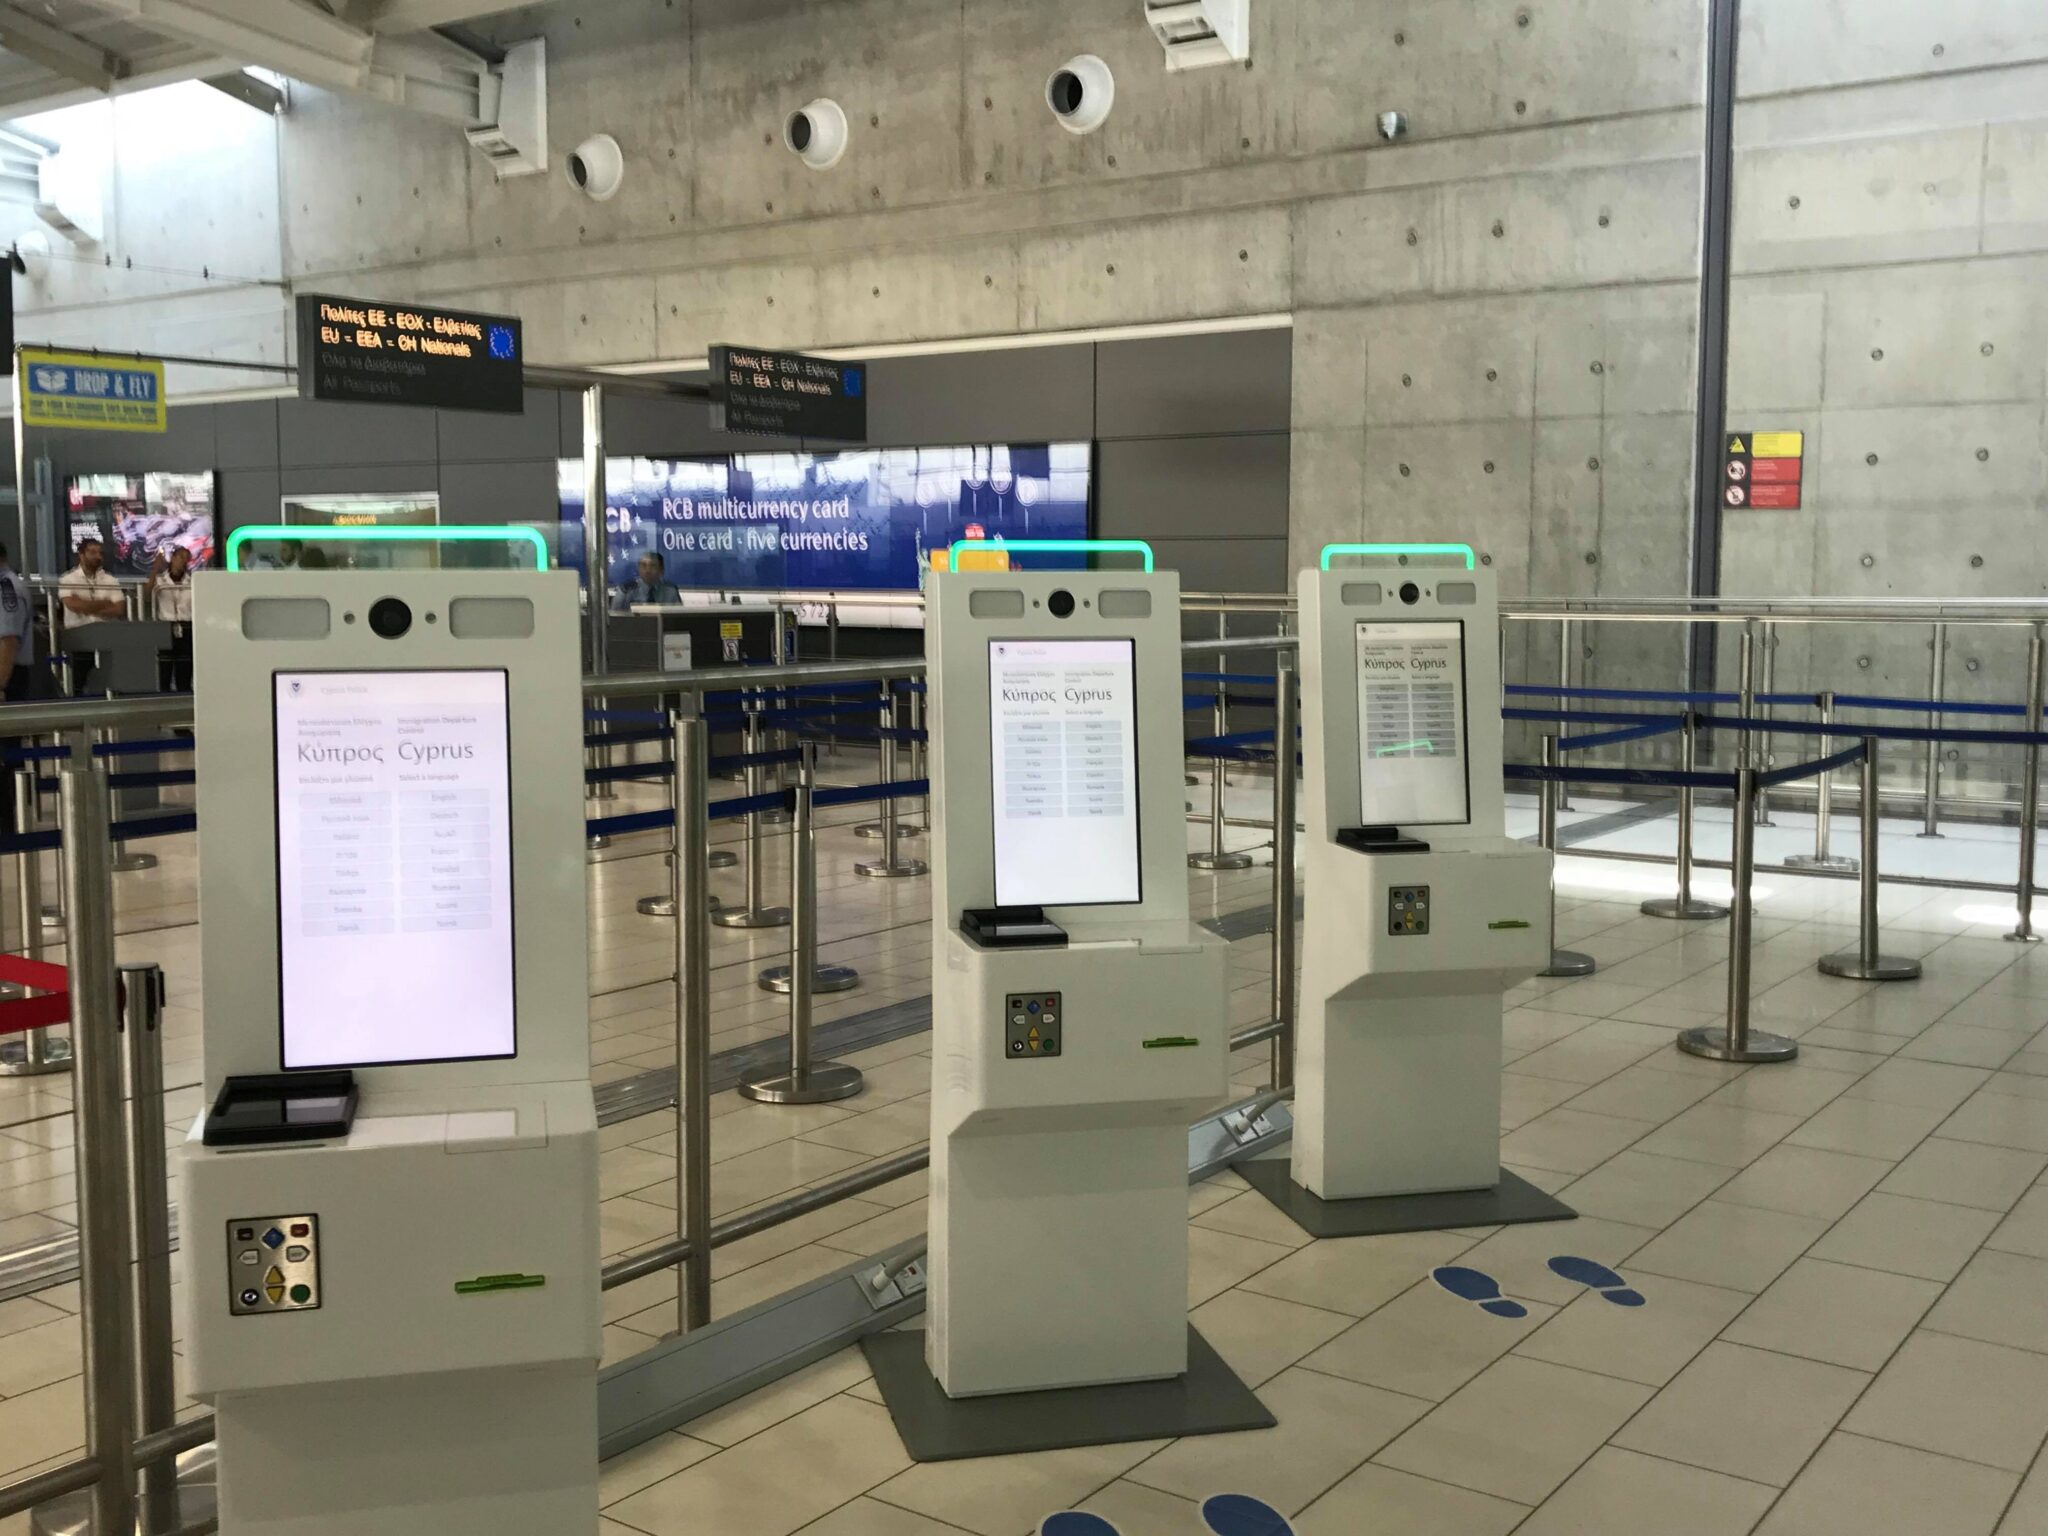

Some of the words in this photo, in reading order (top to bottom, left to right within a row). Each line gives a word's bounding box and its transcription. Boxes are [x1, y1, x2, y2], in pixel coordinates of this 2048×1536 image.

[321, 327, 339, 344] EU
[356, 331, 383, 349] EEA
[398, 335, 417, 351] CH
[421, 337, 471, 358] Nationals
[74, 369, 109, 396] DROP
[114, 374, 125, 397] &
[128, 375, 151, 399] FLY
[606, 506, 631, 533] CB
[663, 497, 694, 520] RCB
[698, 497, 808, 524] multicurrency
[812, 495, 849, 519] card
[663, 527, 695, 551] One
[700, 527, 733, 551] card
[747, 527, 776, 550] five
[780, 527, 868, 551] currencies
[1364, 658, 1405, 671] Κύπρος
[1410, 658, 1447, 671] Cyprus
[1002, 688, 1056, 704] Κύπρος
[1065, 688, 1112, 704] Cyprus
[298, 742, 384, 766] Κύπρος
[398, 739, 474, 765] Cyprus
